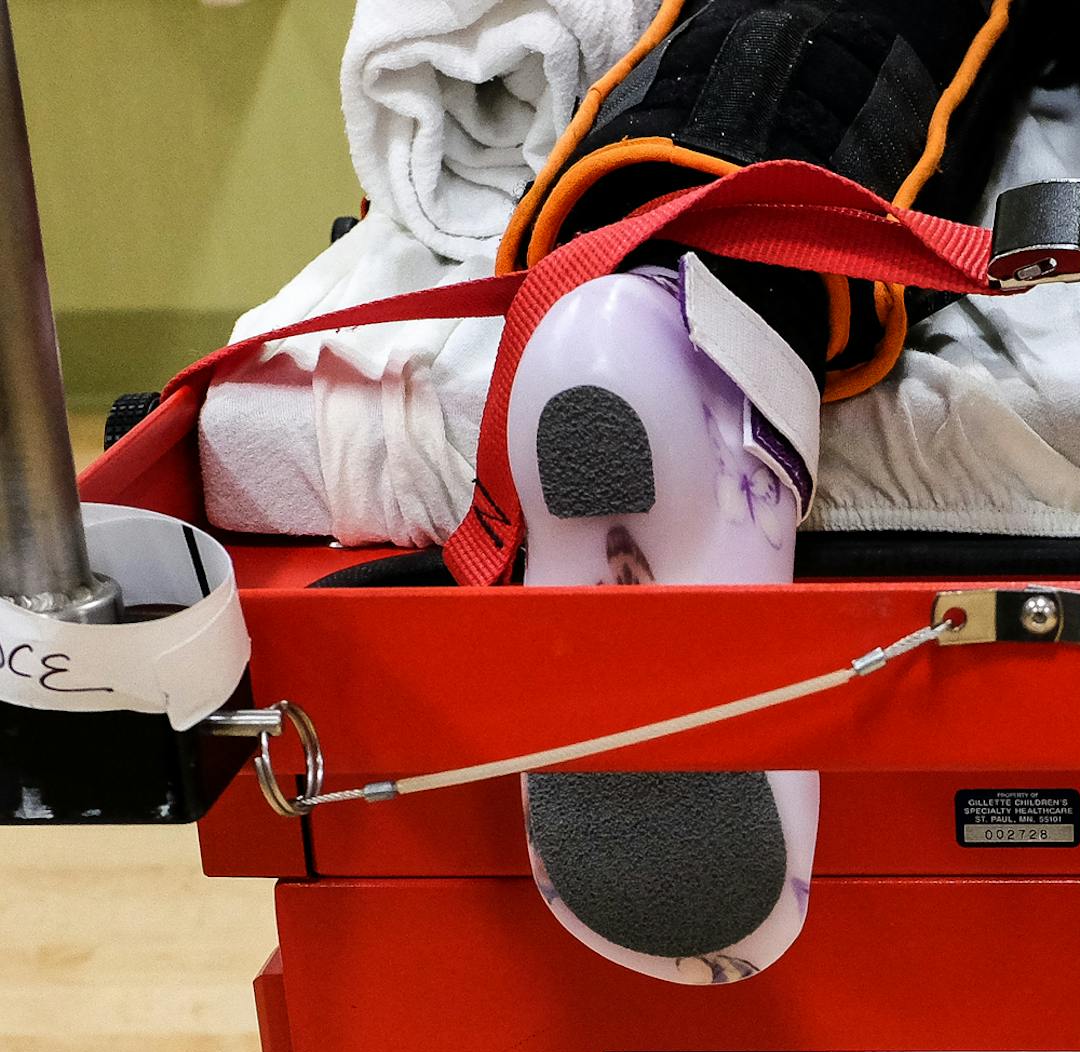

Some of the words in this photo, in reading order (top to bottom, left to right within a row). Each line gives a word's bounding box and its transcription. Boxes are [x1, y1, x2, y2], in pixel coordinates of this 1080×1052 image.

[968, 799, 1012, 807] GILLETTE
[1014, 799, 1068, 807] CHILDREN'S
[964, 807, 1014, 815] SPECIALTY
[1014, 807, 1073, 815] HEALTHCARE
[985, 829, 1048, 840] 002728
